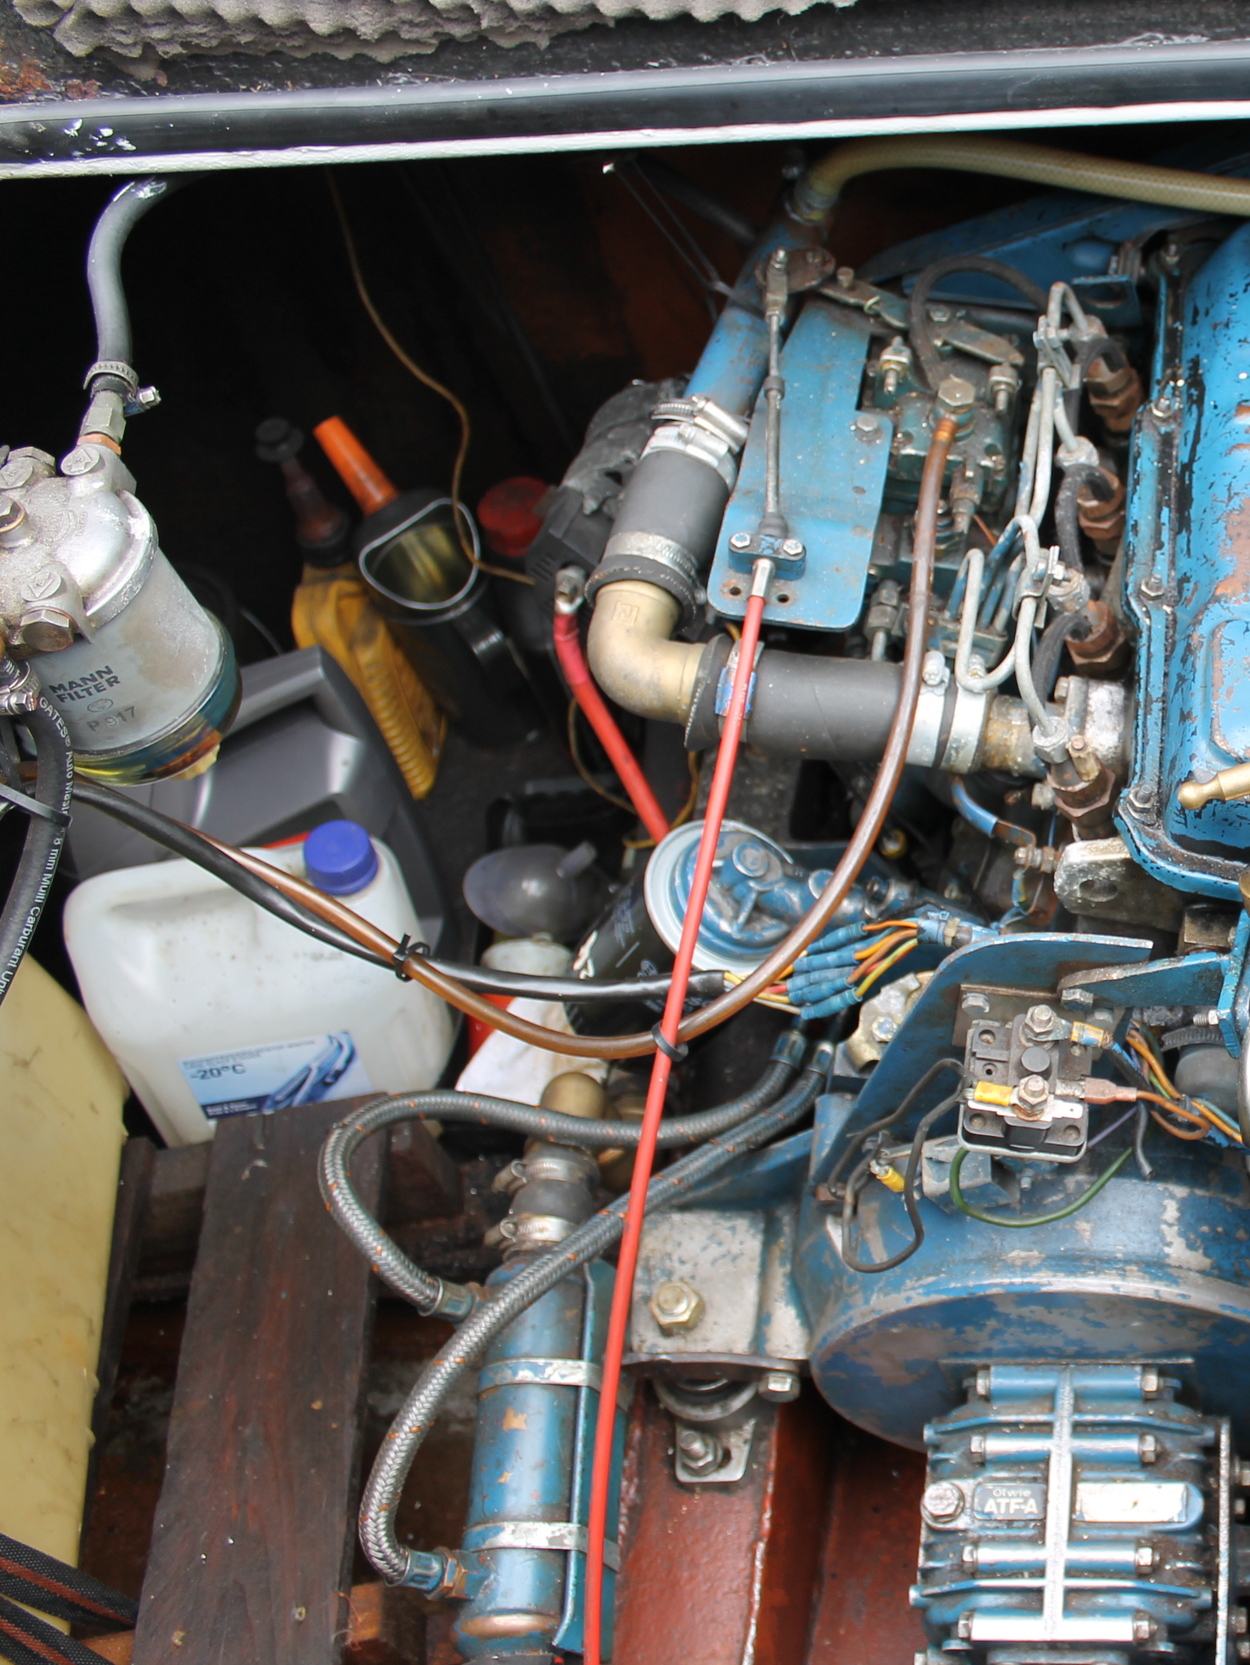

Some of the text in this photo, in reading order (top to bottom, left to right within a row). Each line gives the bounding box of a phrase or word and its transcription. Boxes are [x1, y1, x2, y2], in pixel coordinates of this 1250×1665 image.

[49, 665, 114, 694] MANN
[56, 675, 121, 703] FILTER
[65, 751, 74, 779] Auto
[45, 848, 58, 870] mm
[34, 873, 52, 903] Multi
[7, 906, 41, 968] Carburant
